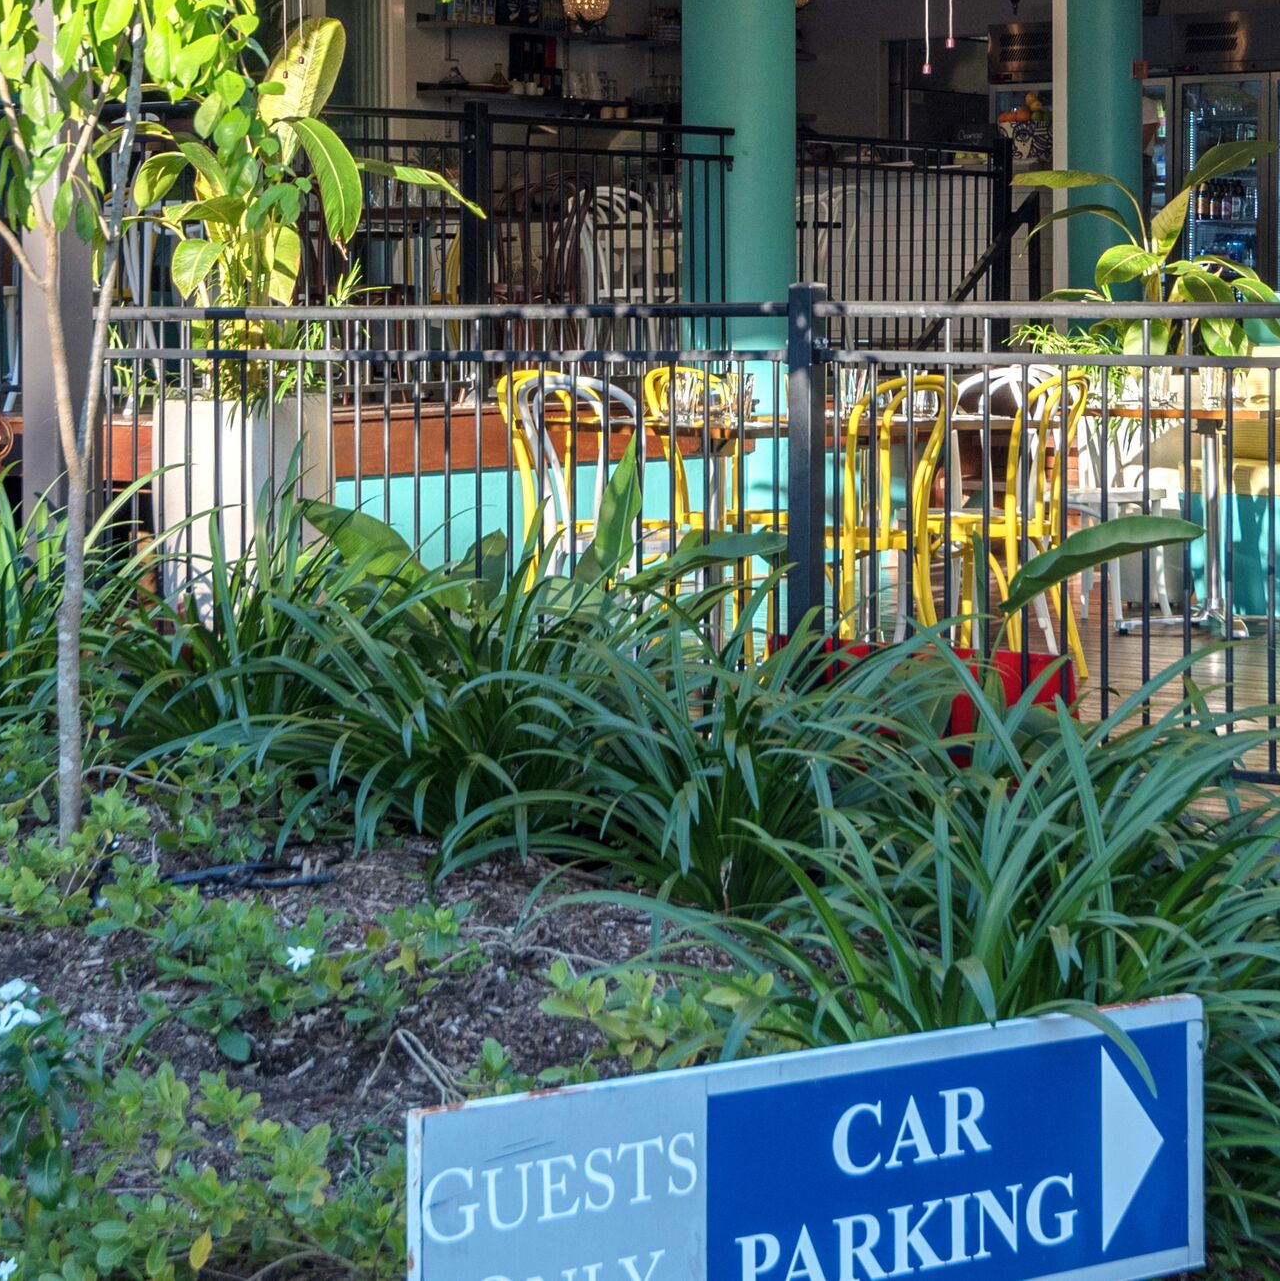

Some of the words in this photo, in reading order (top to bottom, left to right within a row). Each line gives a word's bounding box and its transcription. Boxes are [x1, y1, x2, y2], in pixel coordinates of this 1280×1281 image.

[831, 1086, 993, 1176] CAR
[421, 1131, 698, 1243] GUESTS
[735, 1172, 1078, 1281] PARKING
